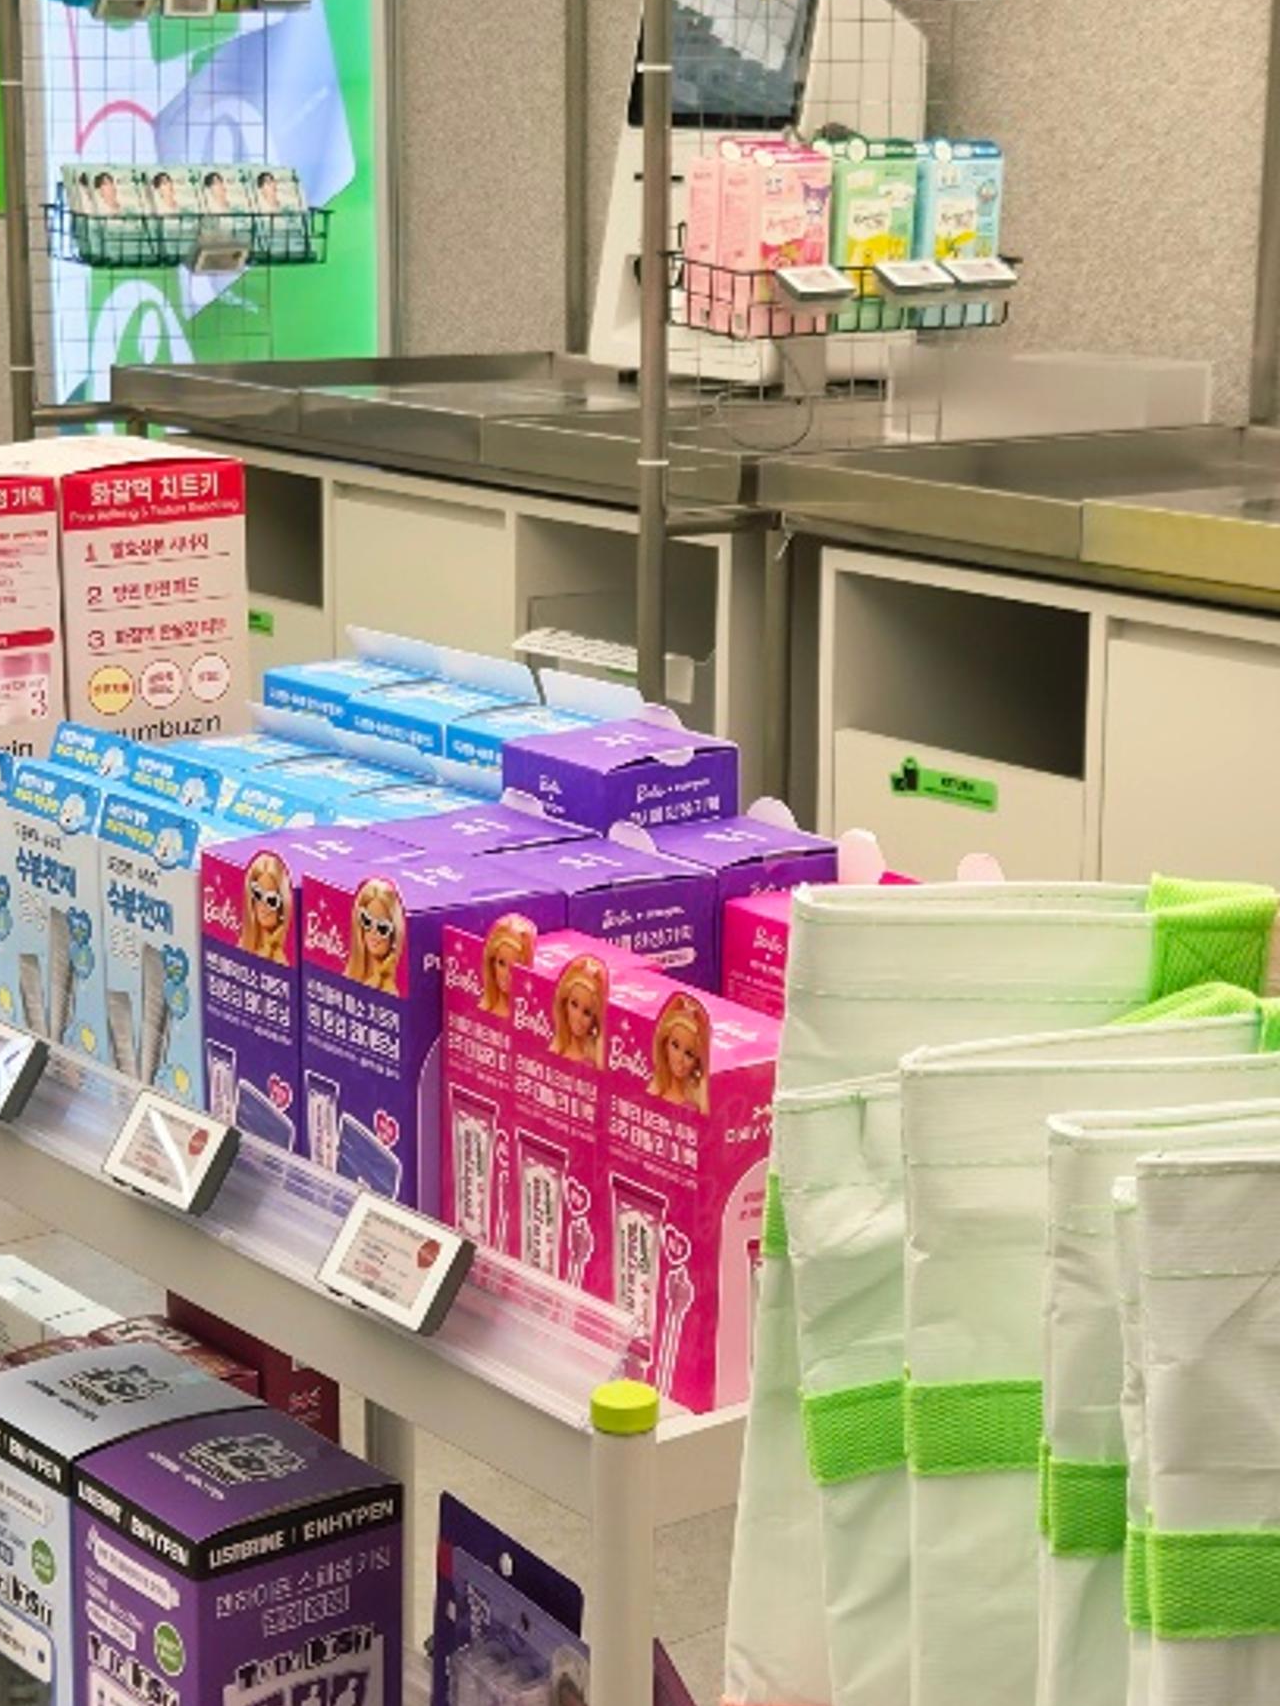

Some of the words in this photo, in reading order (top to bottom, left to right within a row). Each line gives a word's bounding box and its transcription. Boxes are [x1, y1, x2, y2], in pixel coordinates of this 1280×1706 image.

[159, 471, 219, 500] 치트키
[87, 585, 103, 606] 2
[87, 629, 106, 650] 3
[305, 911, 348, 958] Barbie
[513, 997, 554, 1039] Barbie
[608, 1036, 653, 1081] Barbie
[209, 1529, 285, 1570] LISTERINE
[302, 1499, 395, 1543] ENHYPEN
